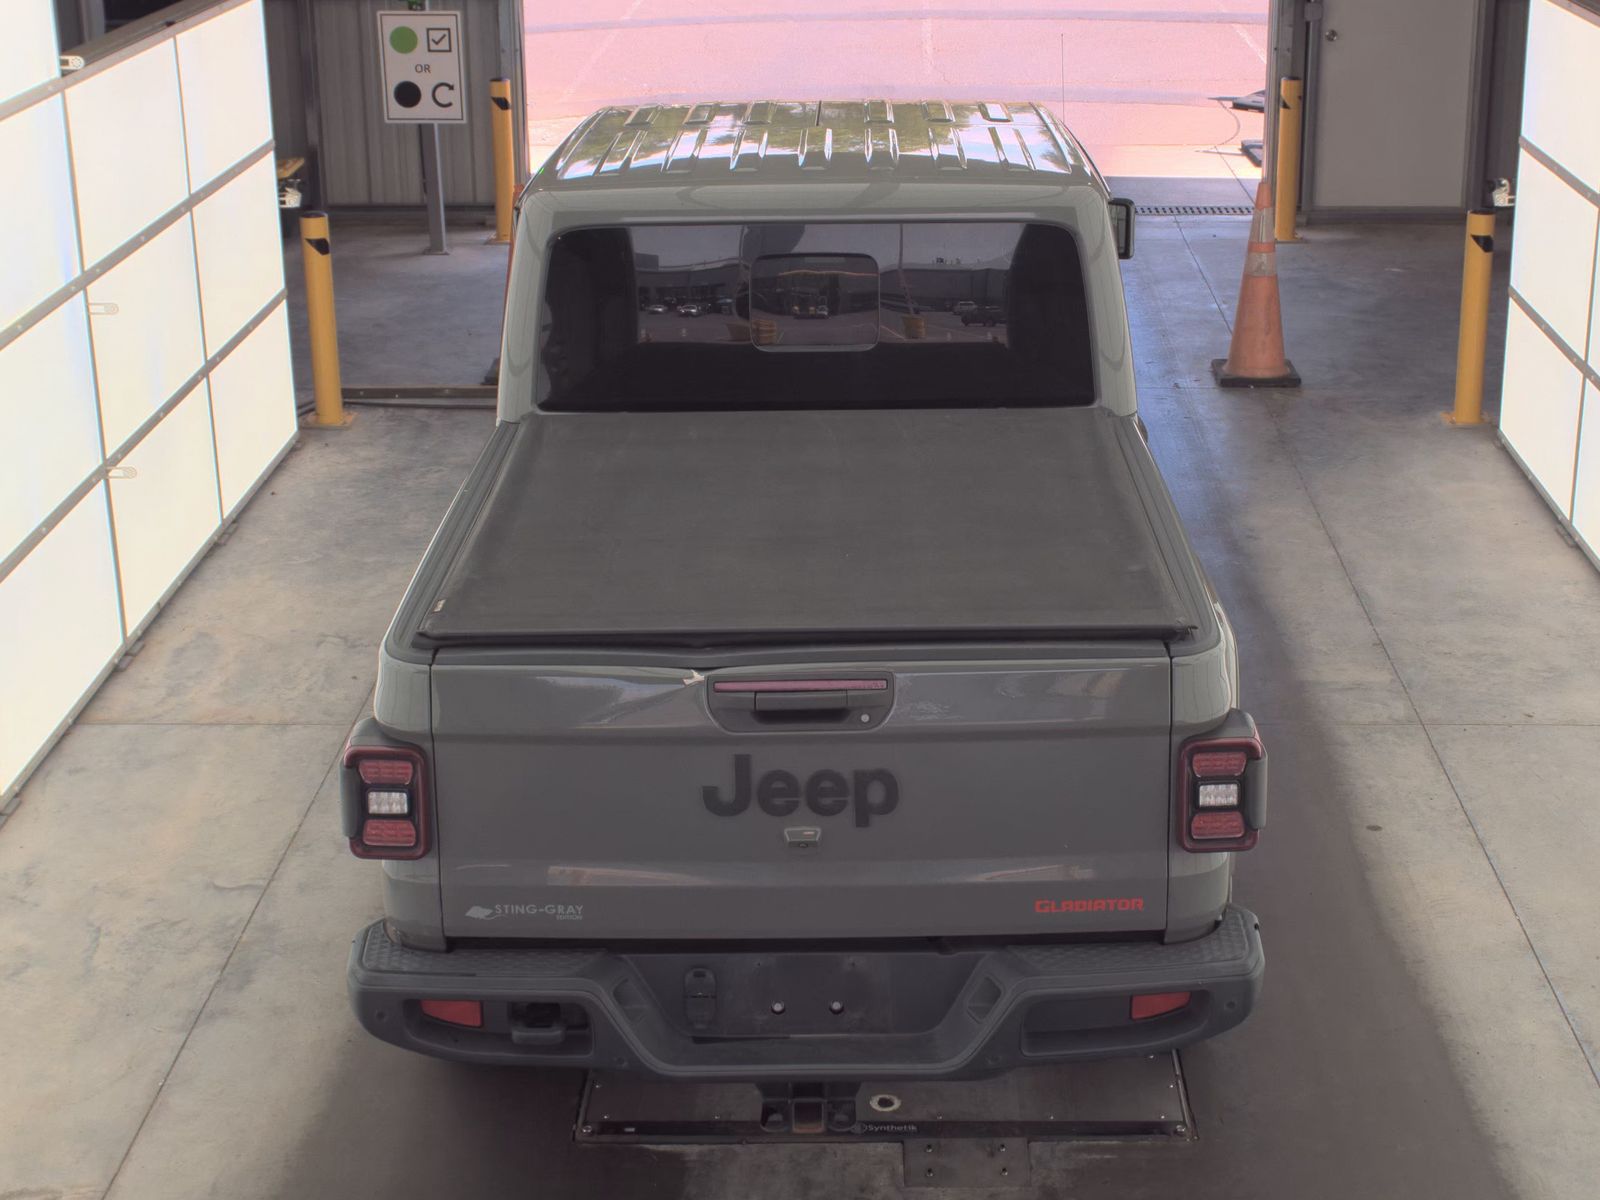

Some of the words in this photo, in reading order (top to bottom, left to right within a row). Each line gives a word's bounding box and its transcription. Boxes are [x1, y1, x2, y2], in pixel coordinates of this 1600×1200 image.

[414, 63, 431, 74] OR
[702, 754, 899, 828] Jeep
[495, 904, 584, 915] STING-GRAY
[1034, 897, 1144, 912] GLADIATOR
